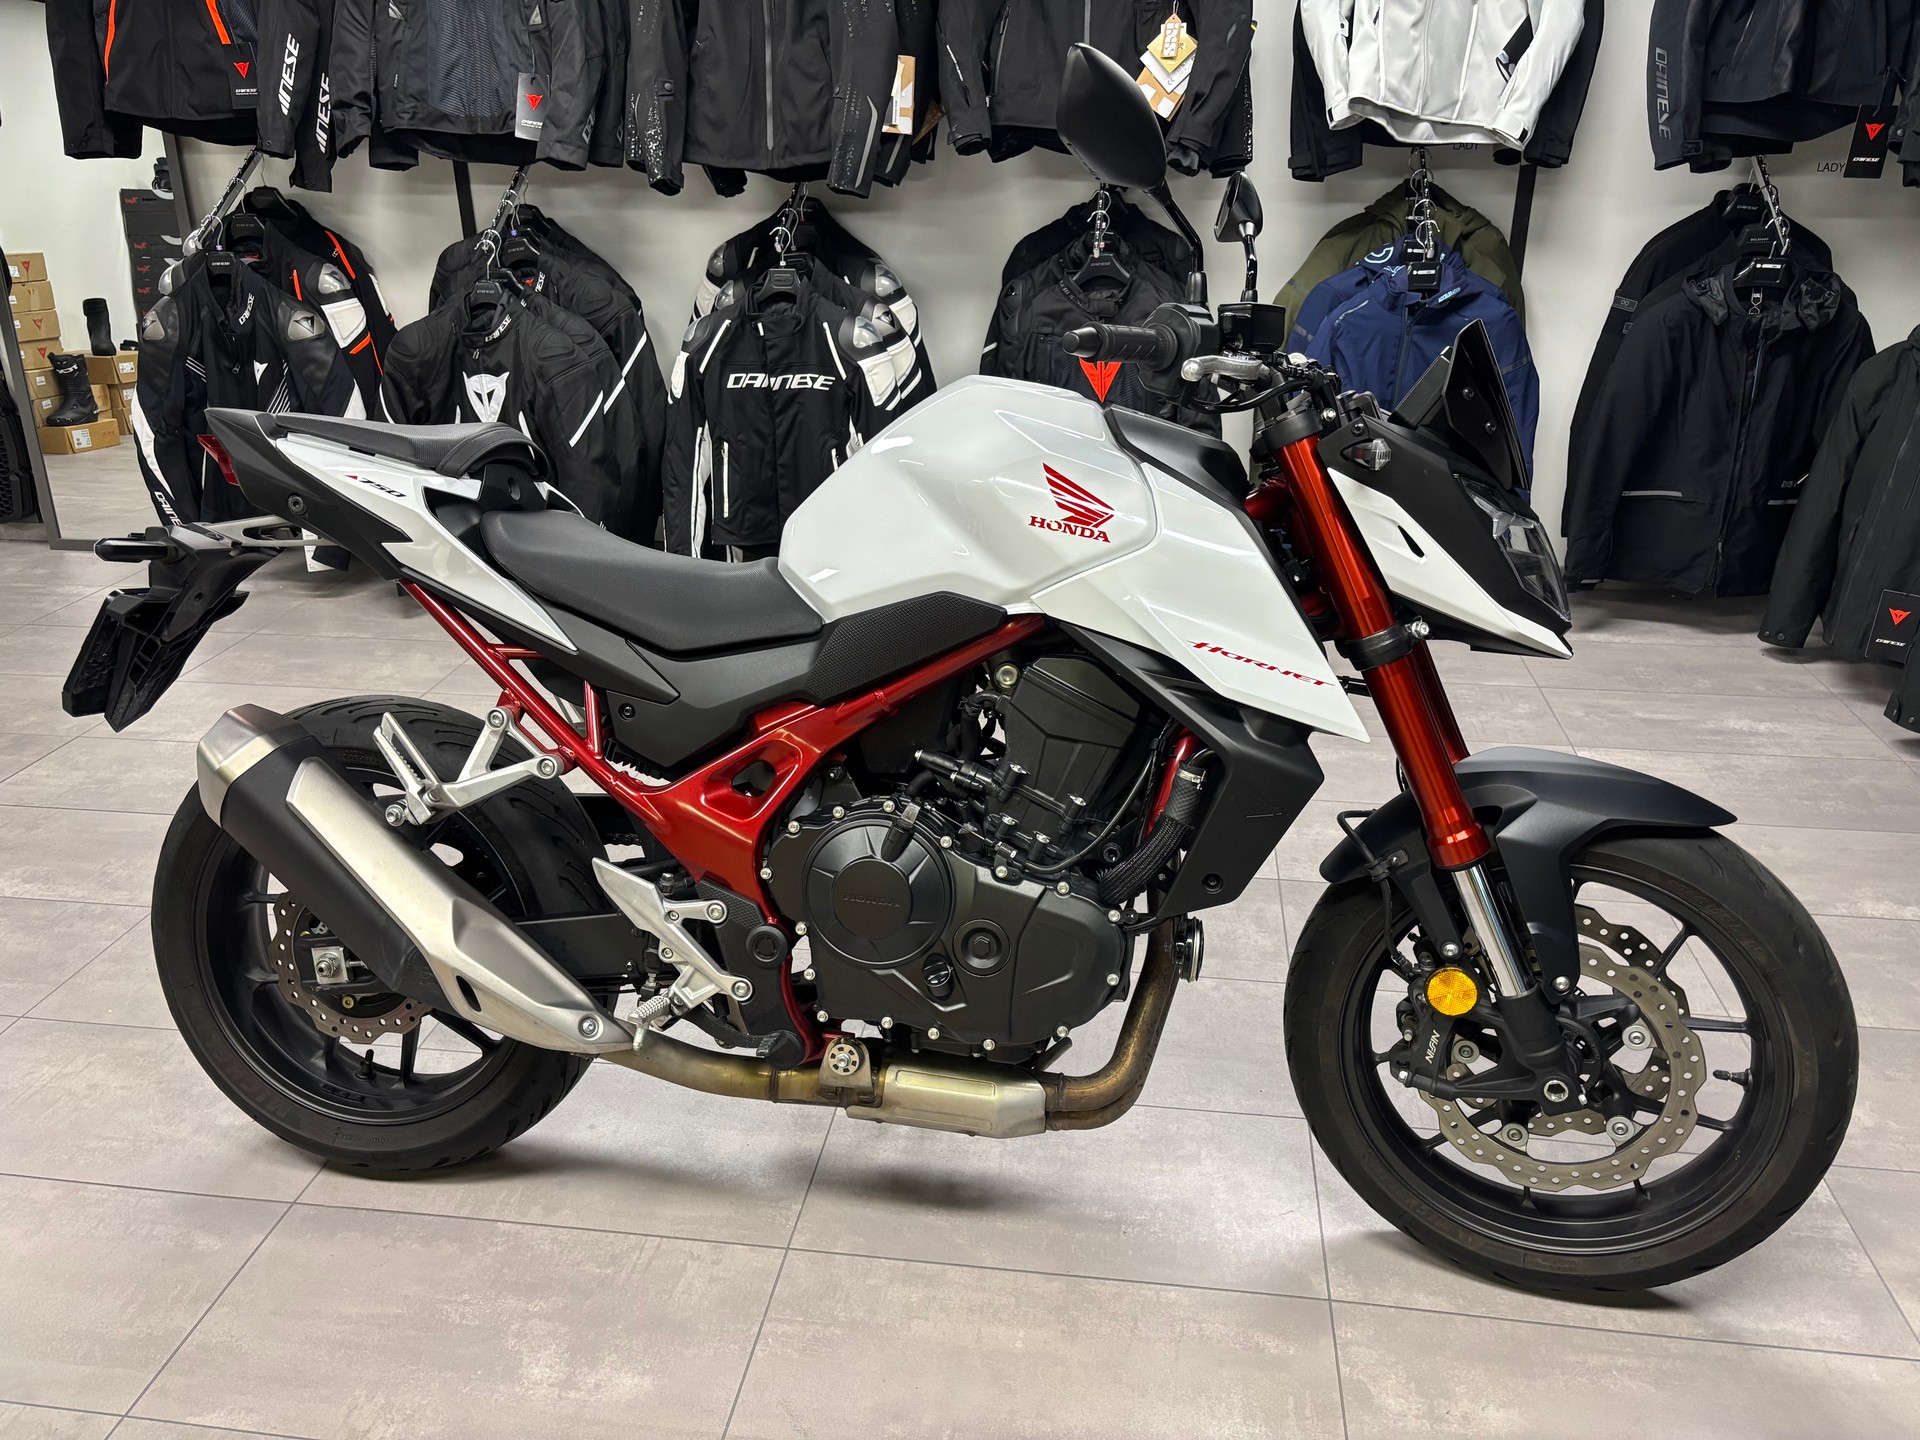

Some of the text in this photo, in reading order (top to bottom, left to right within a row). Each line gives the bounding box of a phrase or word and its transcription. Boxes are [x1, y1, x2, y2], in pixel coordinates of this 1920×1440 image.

[1655, 47, 1672, 140] DAINESE
[1816, 162, 1847, 172] LADY
[238, 292, 256, 325] DAINESE
[484, 313, 512, 343] DAINESE
[359, 477, 408, 498] 750
[1028, 515, 1111, 543] HONDA
[1875, 637, 1907, 647] DAINESE
[842, 892, 902, 908] HONDA
[1424, 1029, 1441, 1064] NISSIN
